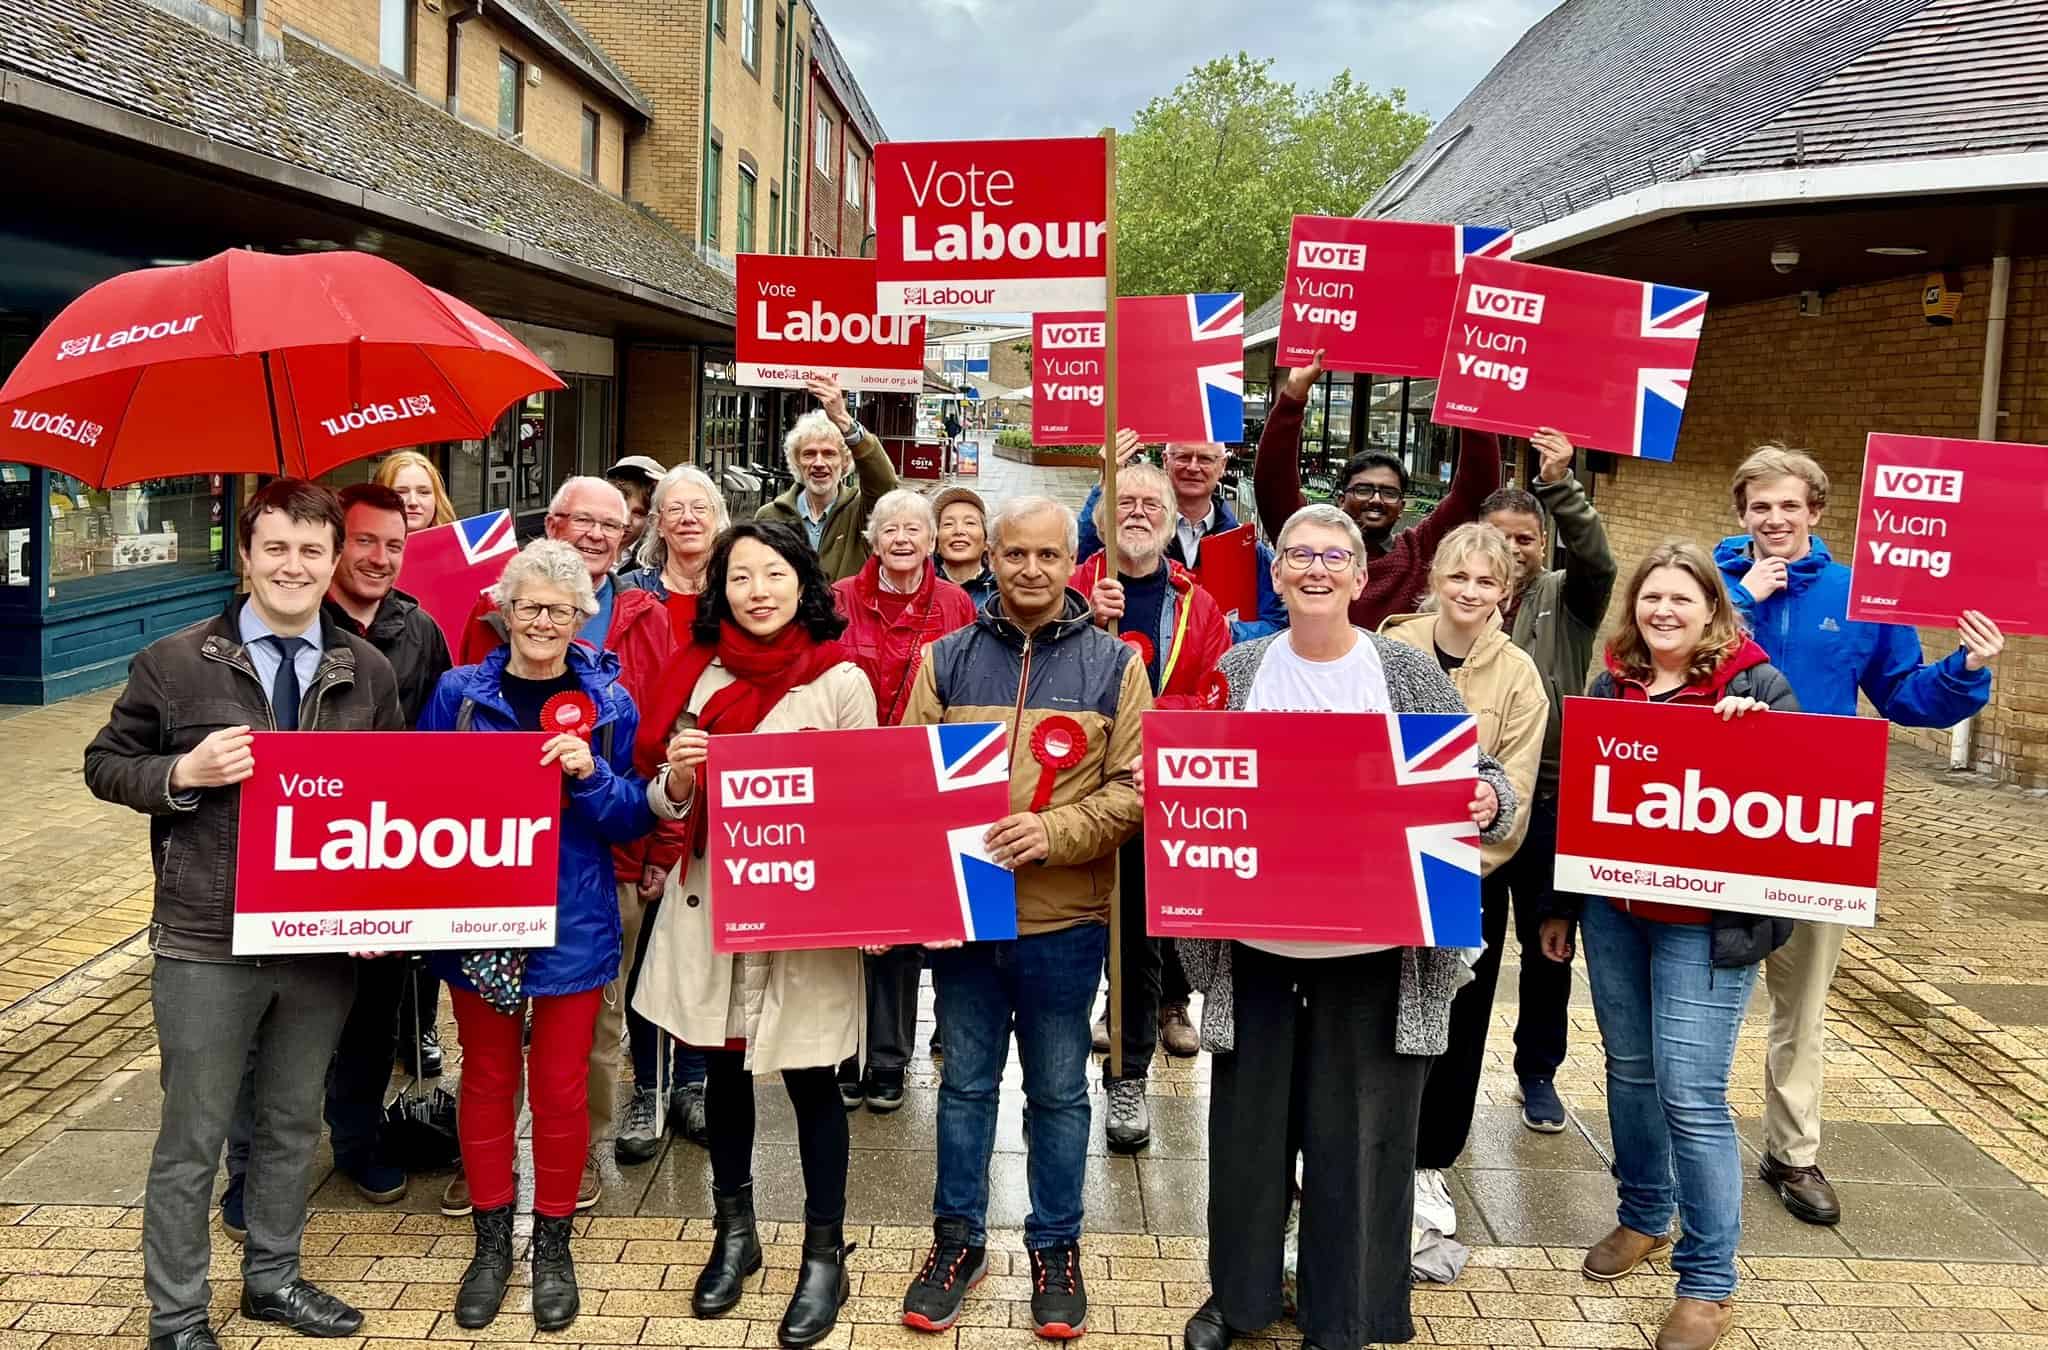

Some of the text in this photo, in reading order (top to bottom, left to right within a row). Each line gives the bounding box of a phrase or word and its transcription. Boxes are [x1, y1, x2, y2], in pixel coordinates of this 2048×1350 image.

[902, 161, 1013, 207] Vote
[903, 212, 1105, 261] Labour
[1304, 247, 1361, 266] VOTE
[758, 281, 795, 297] Vote
[923, 288, 995, 304] Labour
[1296, 277, 1353, 299] Yuan
[1293, 303, 1356, 331] Yang
[1475, 291, 1538, 318] VOTE
[91, 314, 203, 352] Labour
[757, 301, 920, 345] Labour
[1048, 328, 1100, 343] VOTE
[1463, 323, 1528, 354] Yuan
[1043, 358, 1098, 375] Yuan
[1457, 353, 1528, 390] Yang
[861, 376, 918, 386] labour.org.uk
[1043, 383, 1103, 406] Yang
[1883, 471, 1955, 497] VOTE
[1873, 509, 1946, 536] Yuan
[1869, 541, 1951, 577] Yang
[1598, 736, 1658, 761] Vote
[1165, 756, 1248, 780] VOTE
[280, 774, 343, 797] Vote
[728, 774, 806, 799] VOTE
[1160, 801, 1246, 829] Yuan
[1593, 765, 1874, 846] Labour
[275, 801, 551, 870] Labour
[723, 820, 805, 848] Yuan
[1160, 840, 1258, 879] Yang
[724, 857, 815, 891] Yang
[1590, 865, 1726, 893] Vote Labour
[1765, 887, 1867, 910] labour.org.uk
[272, 919, 412, 936] Vote Labour
[452, 920, 546, 935] labour.org.uk
